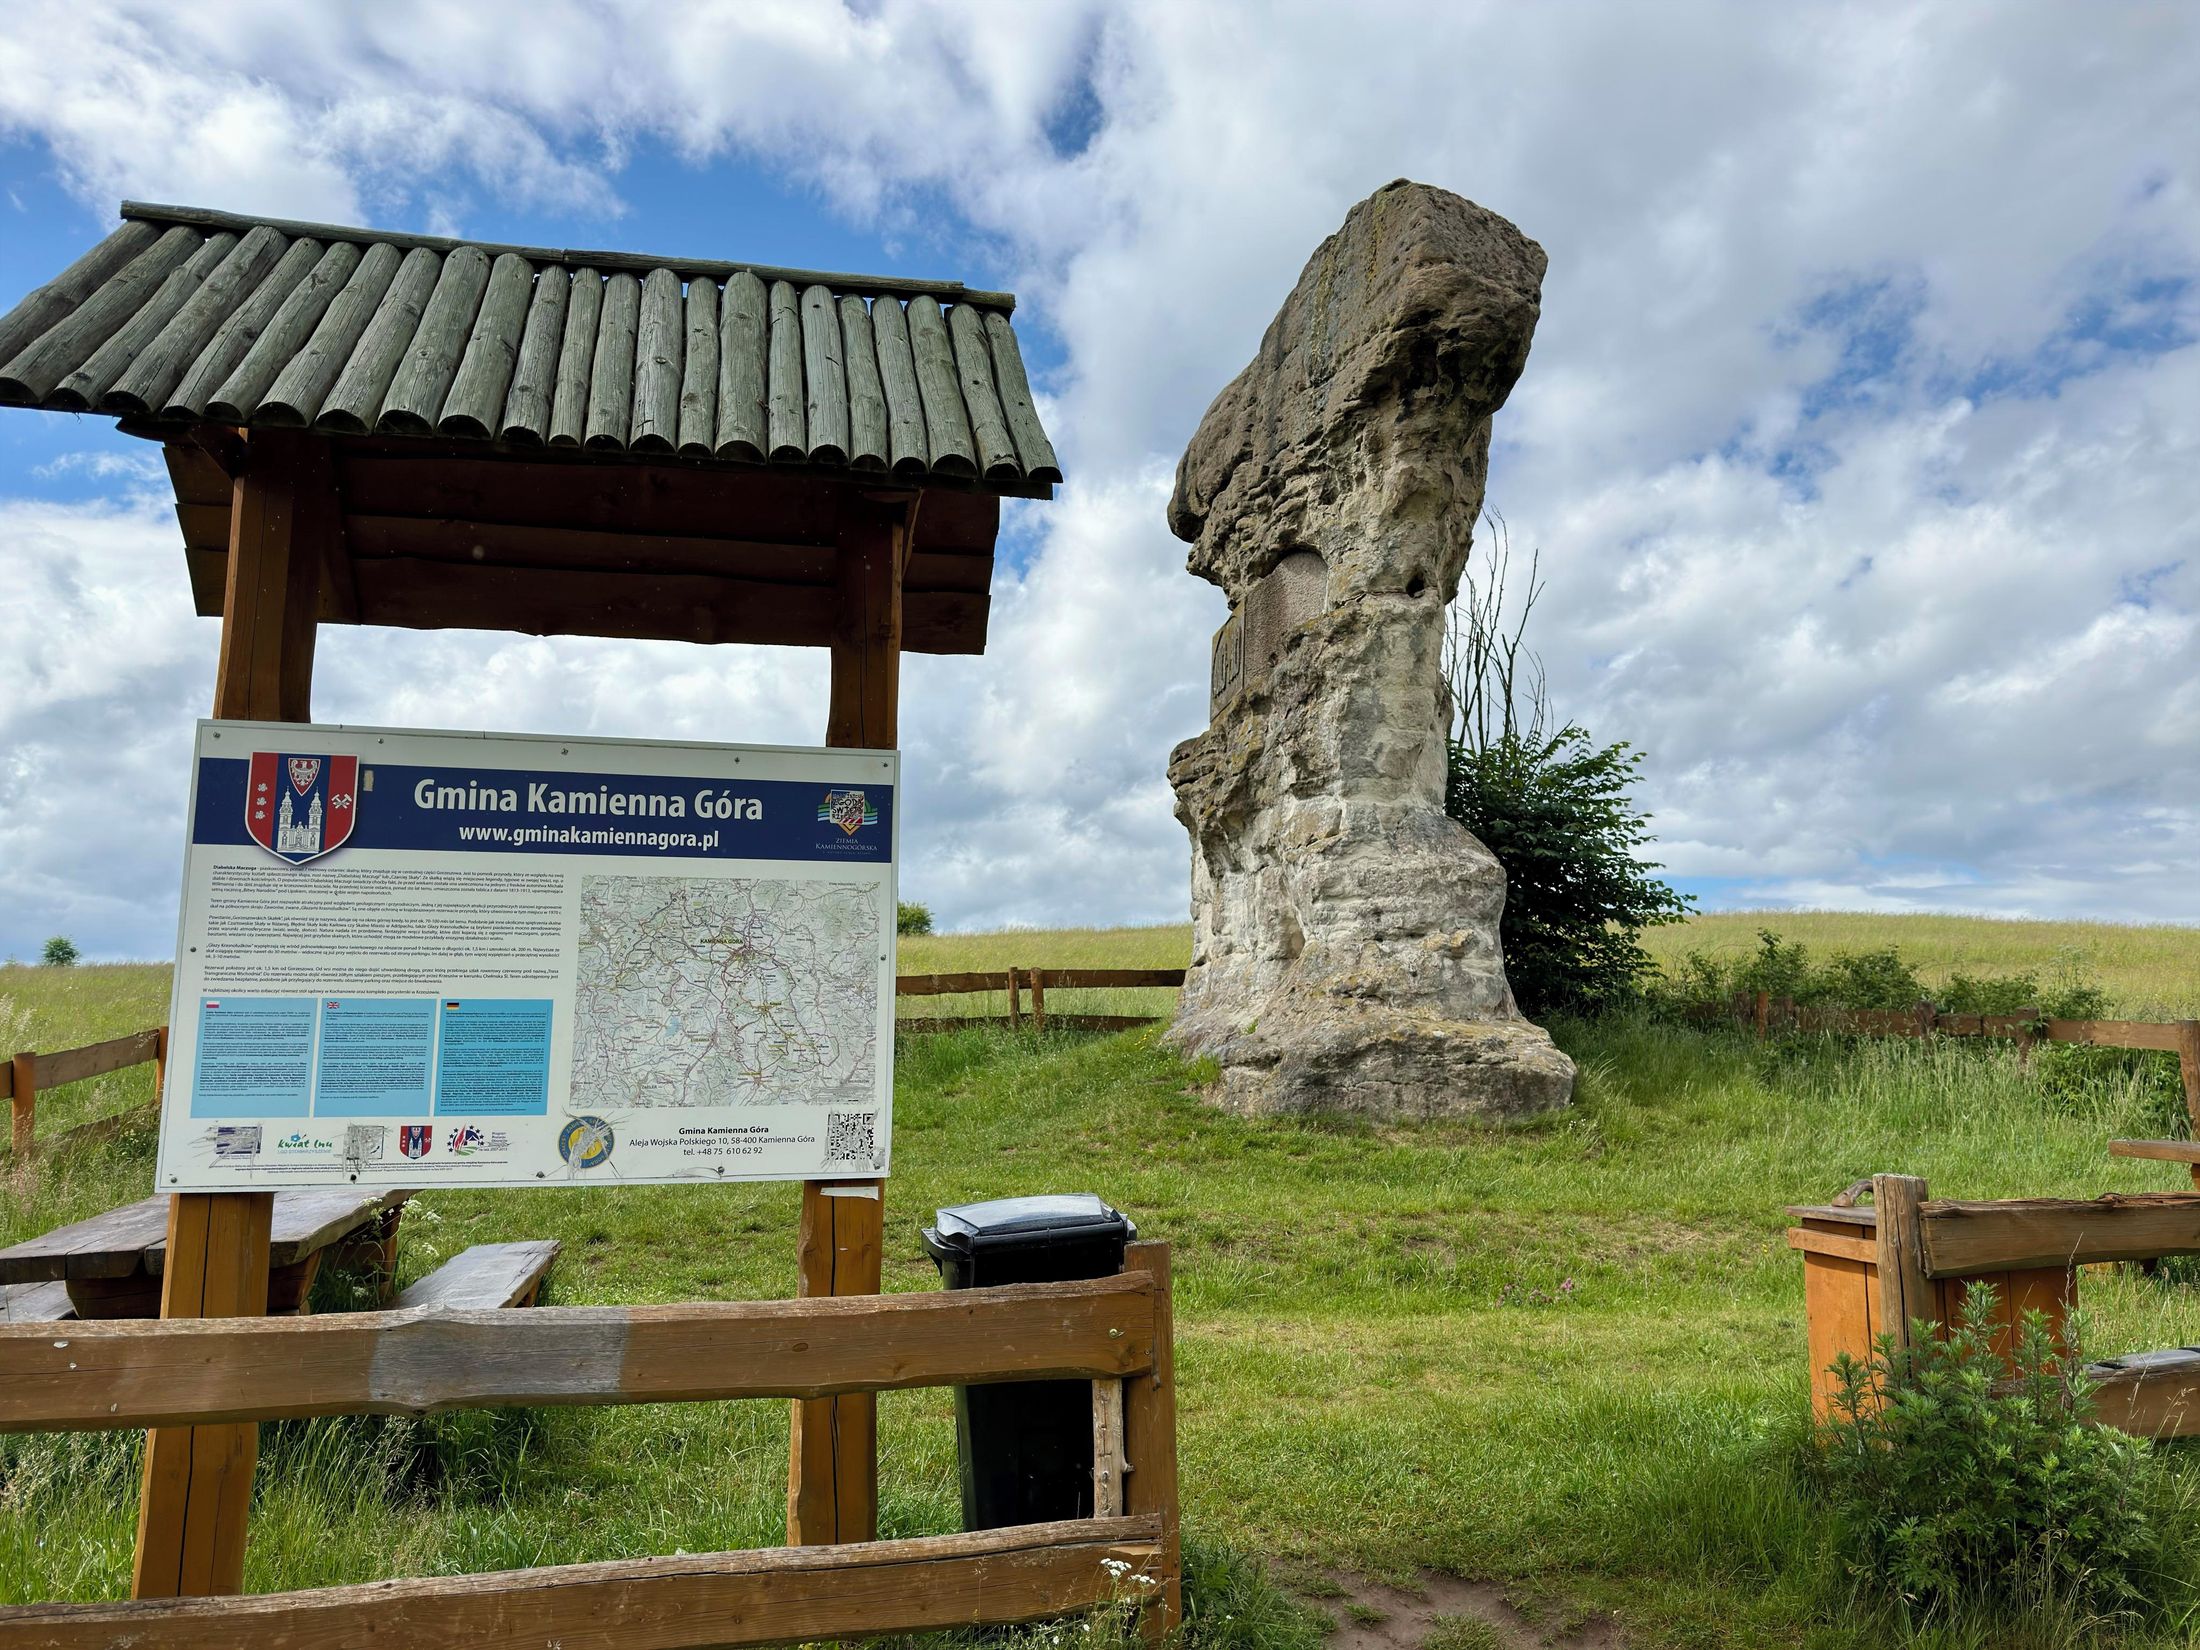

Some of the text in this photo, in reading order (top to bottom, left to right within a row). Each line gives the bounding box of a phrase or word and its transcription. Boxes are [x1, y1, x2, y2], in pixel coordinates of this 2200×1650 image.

[415, 779, 763, 820] Gmina Kamienna Góra
[459, 824, 719, 848] www.gminakamiennagora.pl
[630, 1138, 648, 1148] Aleja
[650, 1138, 677, 1147] Wojska
[680, 1138, 716, 1146] Polskiego
